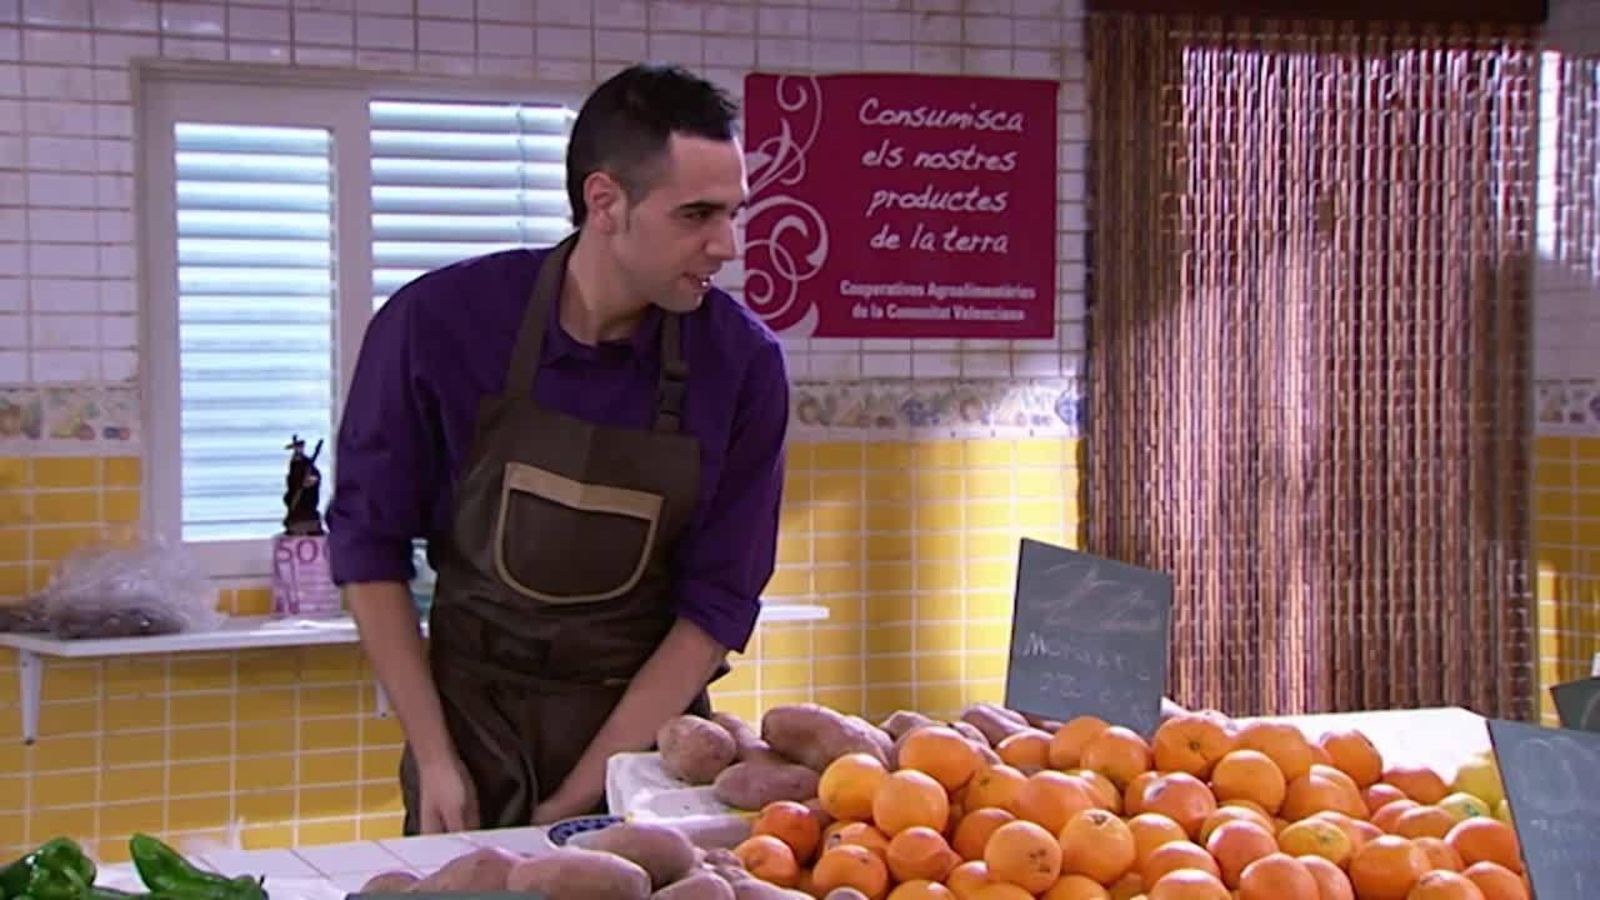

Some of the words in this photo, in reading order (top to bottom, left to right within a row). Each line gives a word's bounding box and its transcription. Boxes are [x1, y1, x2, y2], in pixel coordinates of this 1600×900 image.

[859, 97, 1024, 132] Consumisca
[862, 138, 903, 169] els
[913, 144, 1018, 172] nostres
[865, 184, 1008, 218] productes
[870, 223, 901, 249] de
[910, 222, 936, 251] la
[943, 225, 1009, 254] terra
[839, 279, 925, 299] Cooperatives
[852, 302, 868, 319] de
[870, 302, 884, 319] la
[953, 305, 1026, 321] Valenciana
